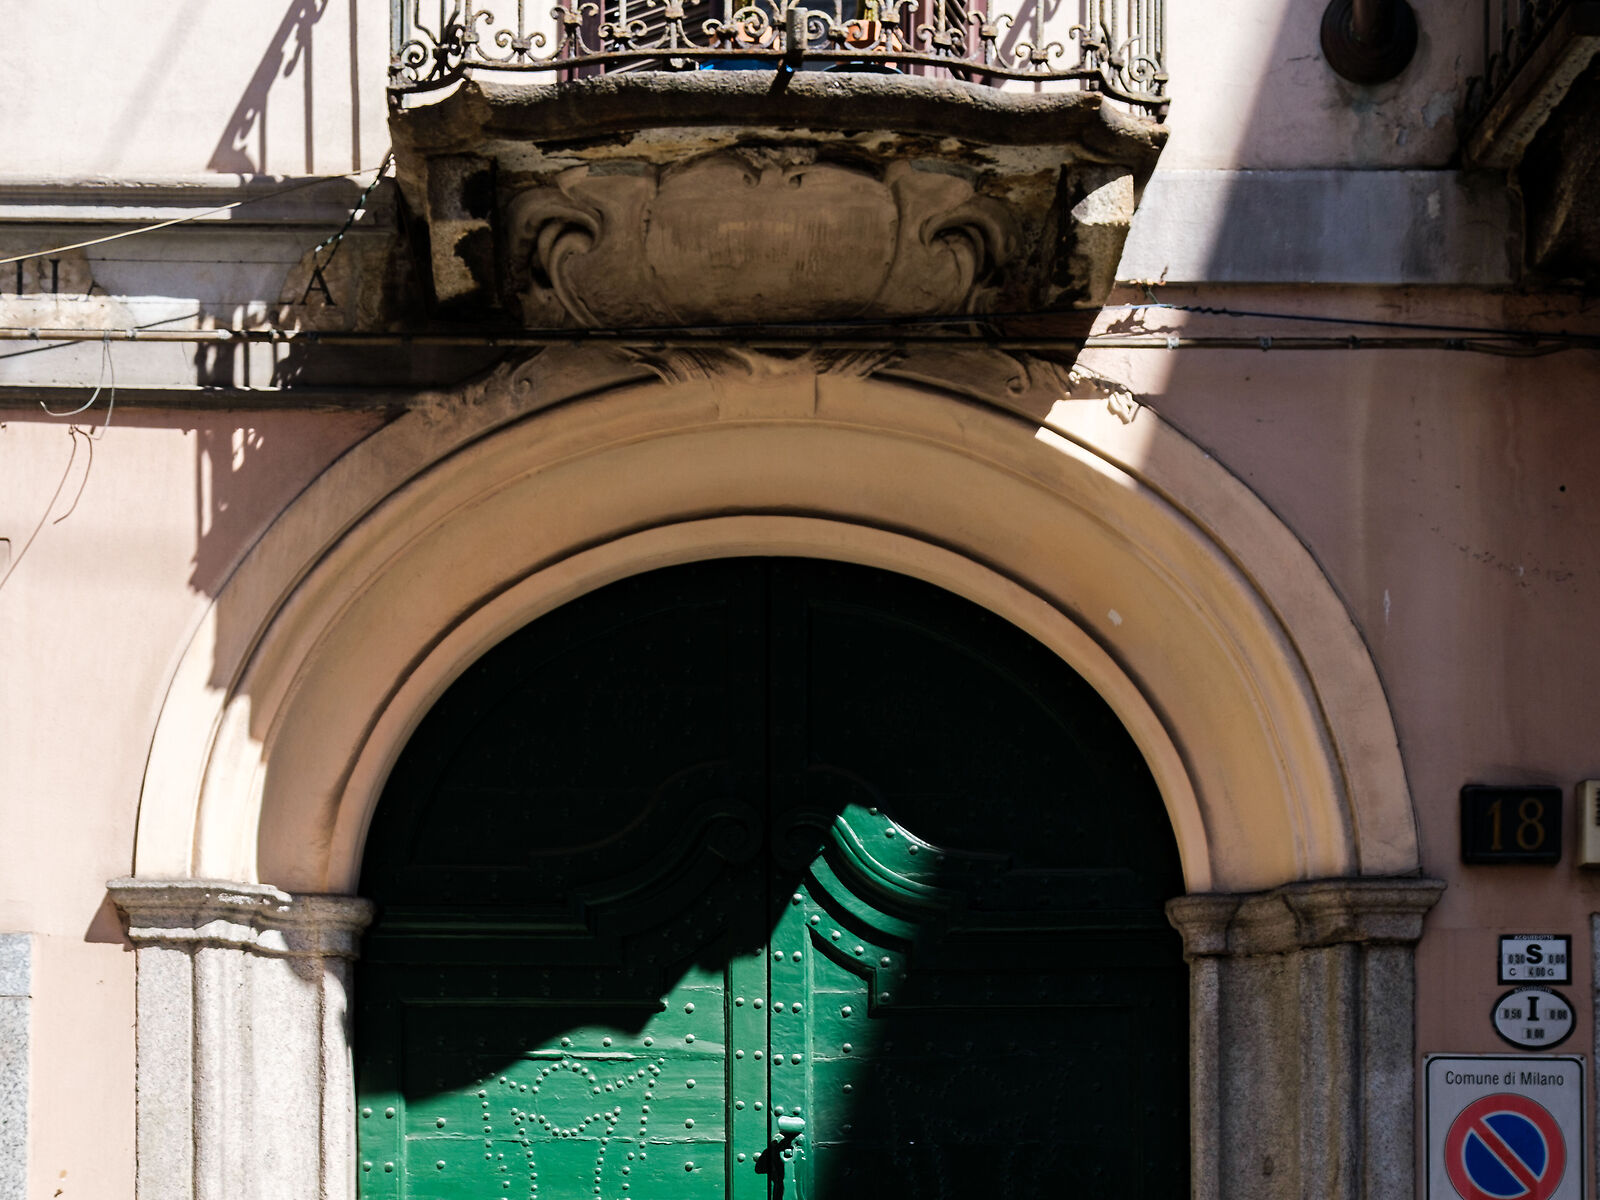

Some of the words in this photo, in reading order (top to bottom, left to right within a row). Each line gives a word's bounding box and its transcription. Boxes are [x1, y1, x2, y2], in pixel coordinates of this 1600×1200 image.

[1487, 797, 1545, 852] 18
[1526, 943, 1543, 965] S
[1509, 967, 1517, 976] C
[1547, 968, 1554, 976] G
[1527, 996, 1540, 1021] I
[1446, 1070, 1499, 1085] Comune
[1504, 1071, 1516, 1085] di
[1520, 1071, 1564, 1086] Milano
